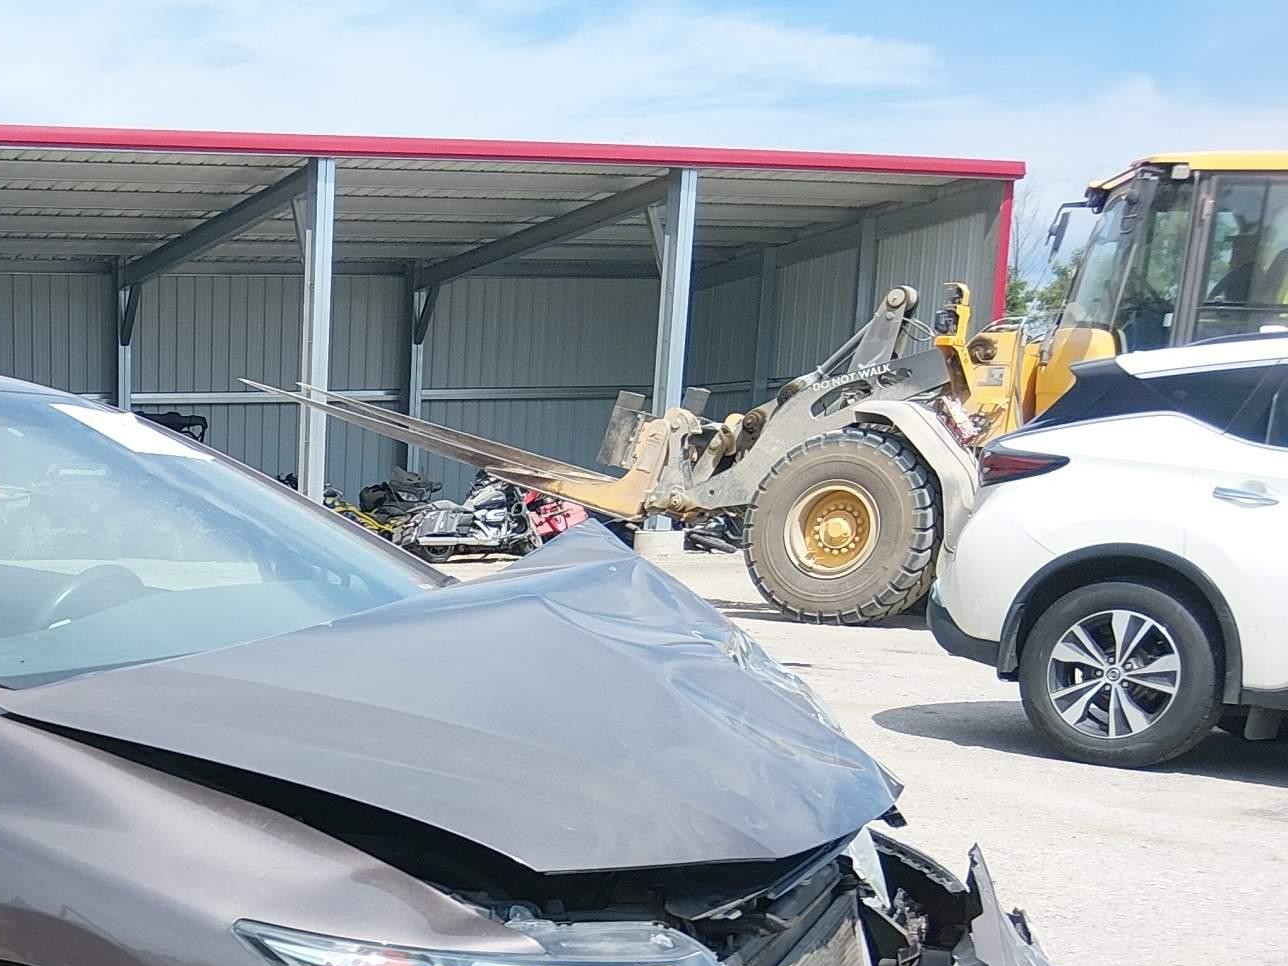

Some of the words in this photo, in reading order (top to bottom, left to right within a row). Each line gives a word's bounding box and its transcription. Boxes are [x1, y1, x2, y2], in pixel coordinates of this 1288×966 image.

[813, 380, 829, 391] DO
[832, 372, 856, 387] NOT
[858, 363, 891, 378] WALK
